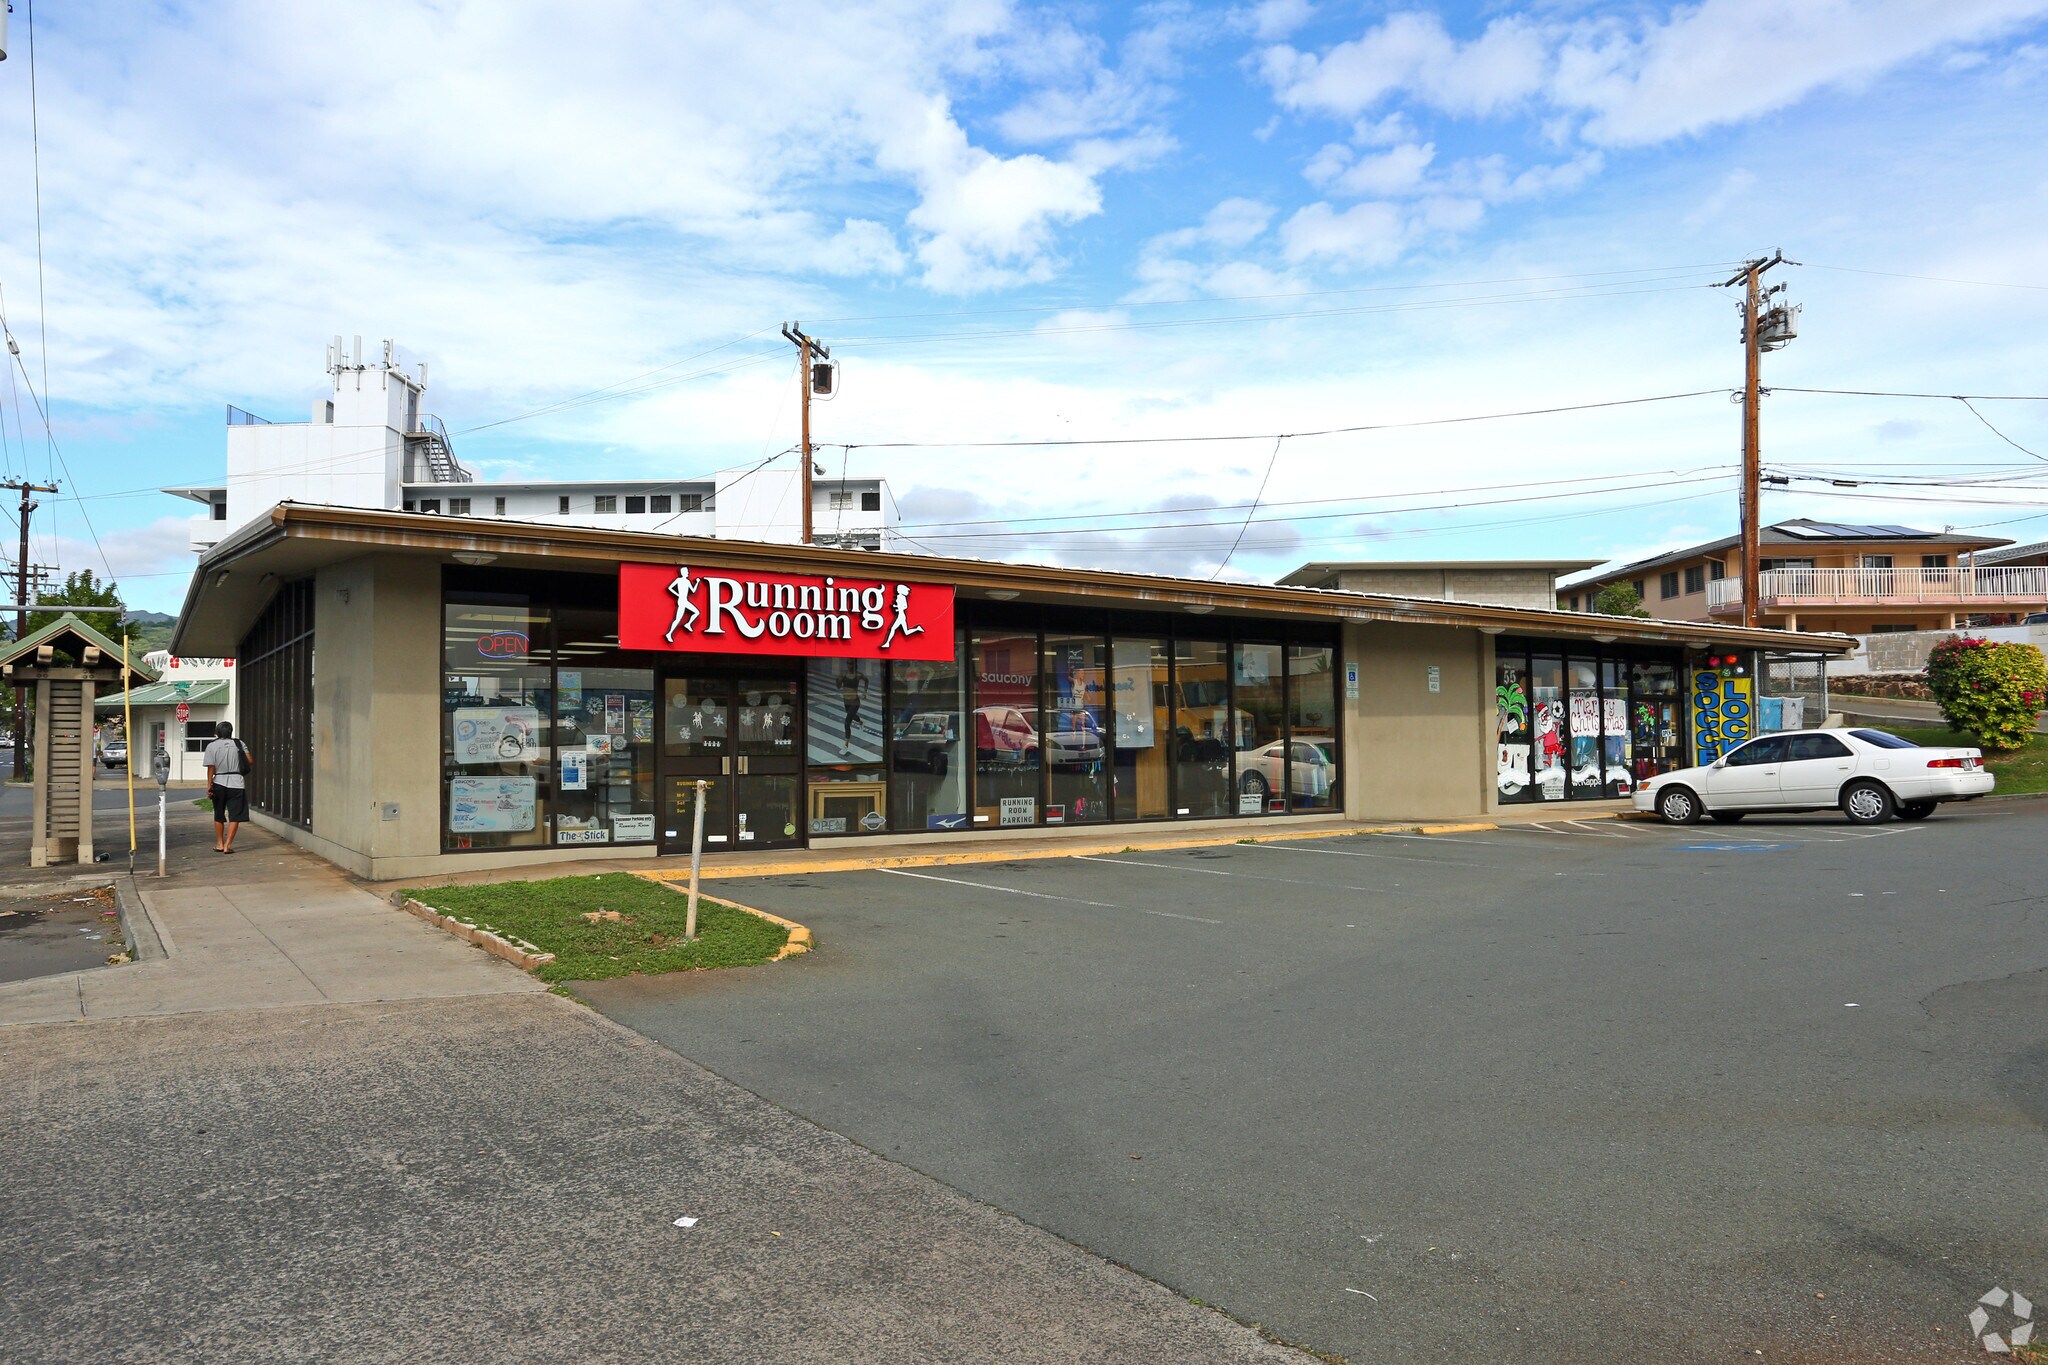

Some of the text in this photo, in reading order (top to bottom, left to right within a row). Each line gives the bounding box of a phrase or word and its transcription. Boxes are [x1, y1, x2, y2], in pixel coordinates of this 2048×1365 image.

[703, 577, 885, 637] Running
[477, 635, 528, 653] OPEN
[981, 672, 1032, 687] saucony
[177, 709, 189, 717] STOP
[559, 831, 576, 840] The
[584, 830, 606, 840] Stick
